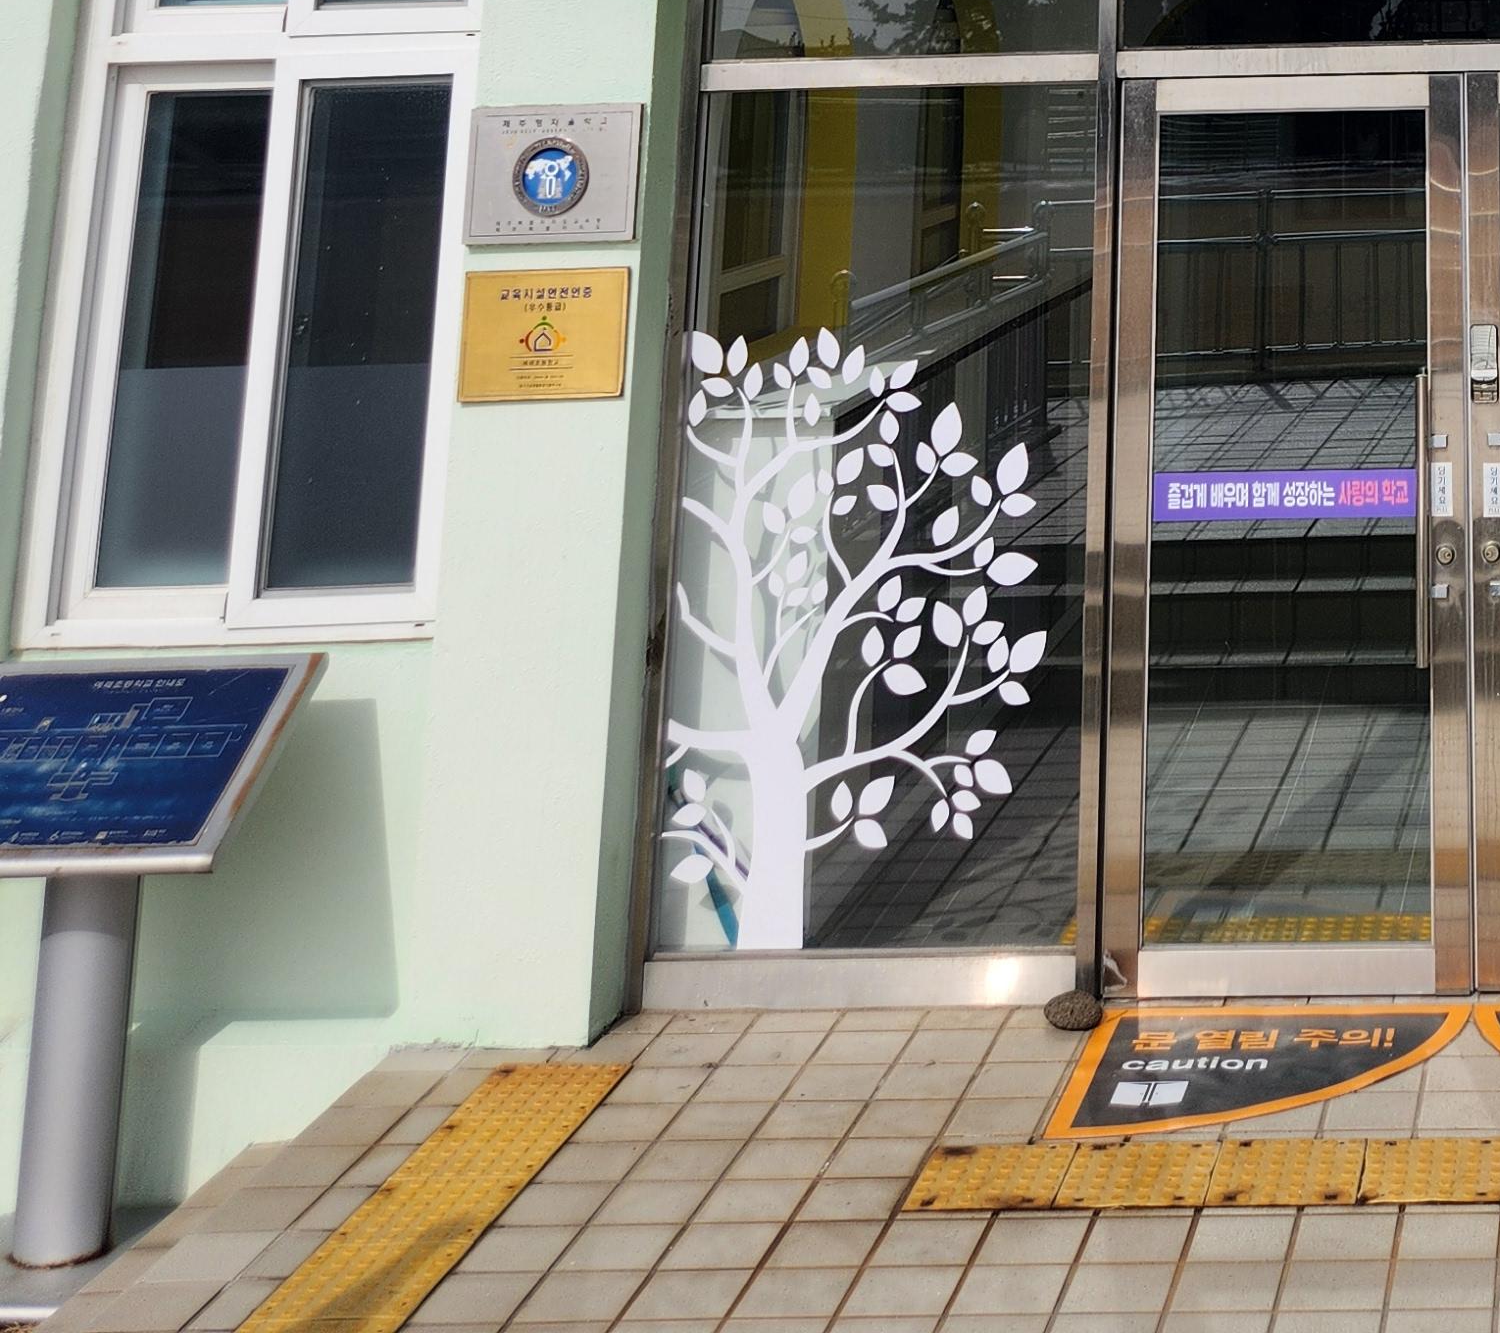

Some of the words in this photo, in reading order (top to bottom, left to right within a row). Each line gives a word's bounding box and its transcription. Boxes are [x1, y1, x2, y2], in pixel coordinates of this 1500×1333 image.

[1167, 482, 1207, 510] 즐겁게
[1210, 482, 1249, 509] 배우며
[1252, 481, 1280, 508] 함께
[1283, 480, 1335, 507] 성장하는
[1338, 480, 1379, 506] 사랑의
[1381, 478, 1409, 504] 학교
[1132, 1030, 1177, 1052] 문
[1196, 1028, 1280, 1051] 열림
[1294, 1027, 1396, 1049] 주의!
[1121, 1055, 1269, 1071] caution
